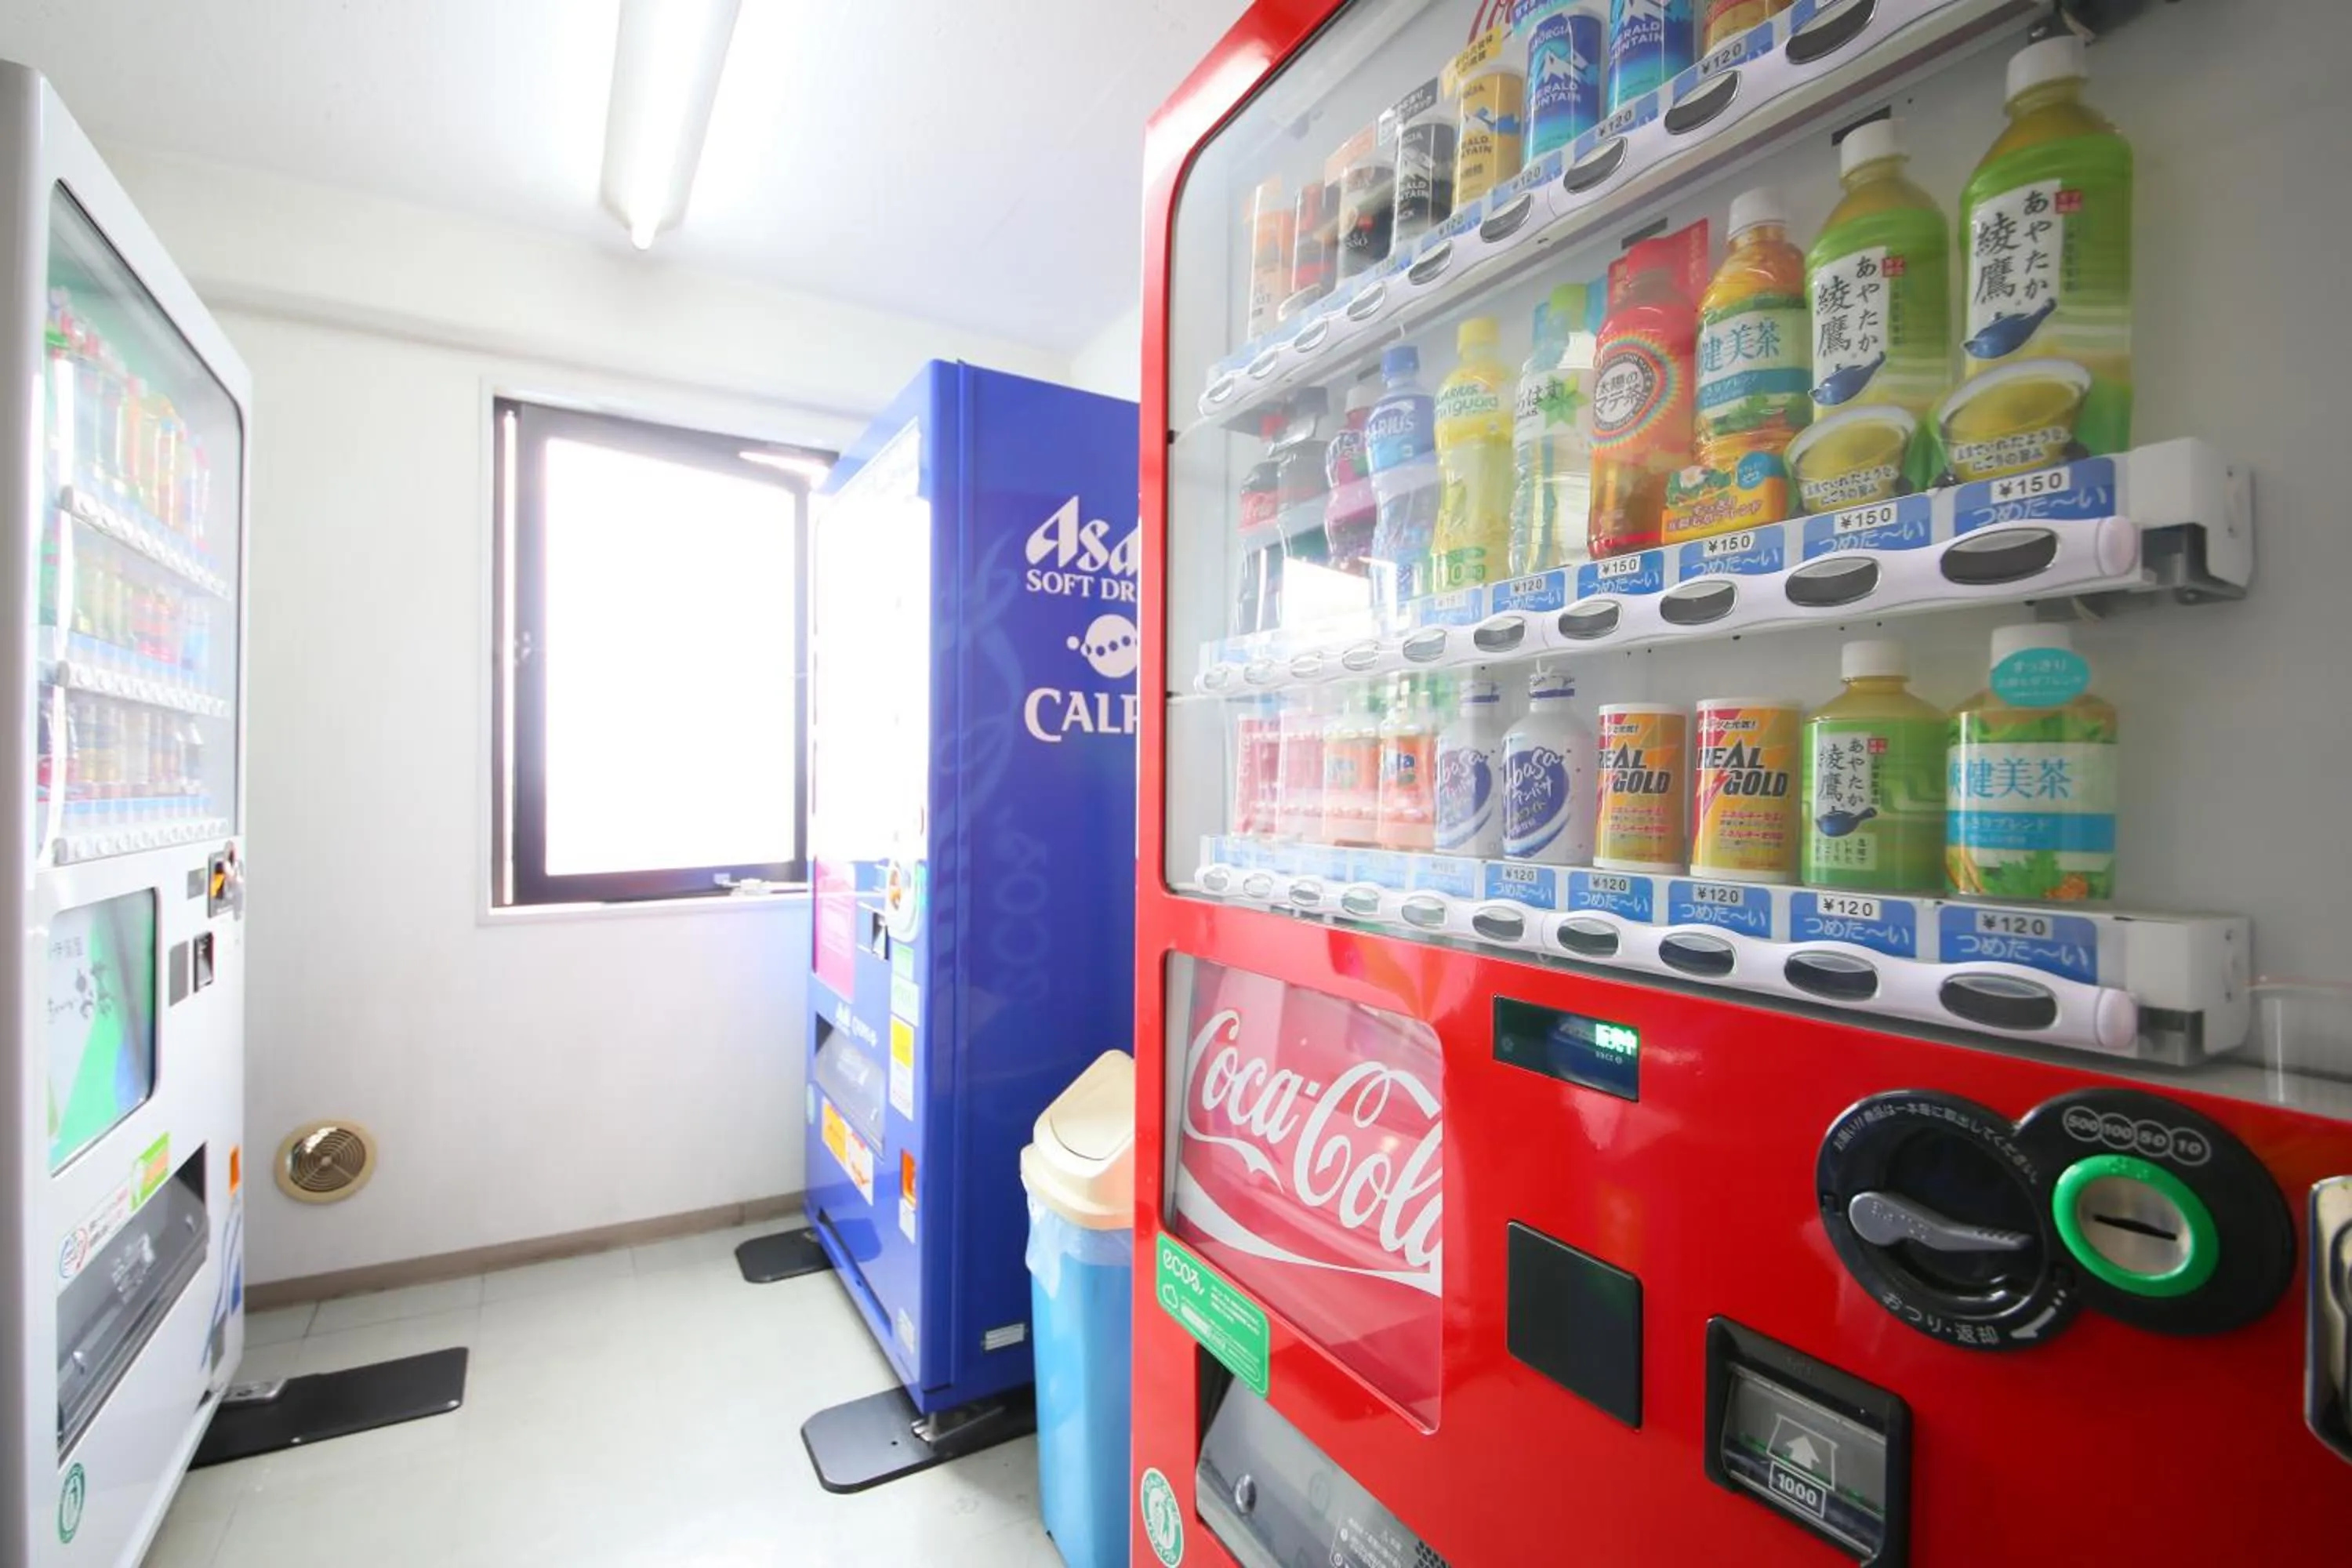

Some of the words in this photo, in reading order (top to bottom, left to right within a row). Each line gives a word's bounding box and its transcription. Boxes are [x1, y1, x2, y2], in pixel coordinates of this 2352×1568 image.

[1700, 43, 1741, 74] ¥120
[1598, 110, 1632, 136] ¥120
[1975, 212, 2020, 304] 綾鷹
[2024, 191, 2053, 300] あやたか
[1817, 276, 1855, 358] 綾鷹
[1856, 256, 1880, 353] あやたか
[1998, 472, 2063, 498] ¥150
[1839, 506, 1892, 529] ¥150
[1708, 534, 1751, 553] ¥150
[1602, 557, 1637, 575] ¥150
[1026, 569, 1094, 597] SOFT
[1101, 578, 1136, 602] DR
[1514, 578, 1543, 593] ¥120
[1598, 741, 1647, 769] REAL
[1697, 739, 1765, 769] REAL
[1613, 769, 1672, 795] GOLD
[1723, 769, 1791, 797] GOLD
[1847, 739, 1865, 807] あやたか
[1505, 869, 1534, 882] ¥120
[1592, 877, 1627, 891] ¥120
[1697, 888, 1740, 904] ¥120
[1823, 898, 1874, 916] ¥120
[1983, 914, 2046, 935] ¥120
[2067, 1114, 2099, 1132] 500
[2104, 1123, 2132, 1139] 100
[2140, 1130, 2167, 1148] 50
[2176, 1139, 2203, 1156] 10
[1777, 1472, 1818, 1507] 1000
